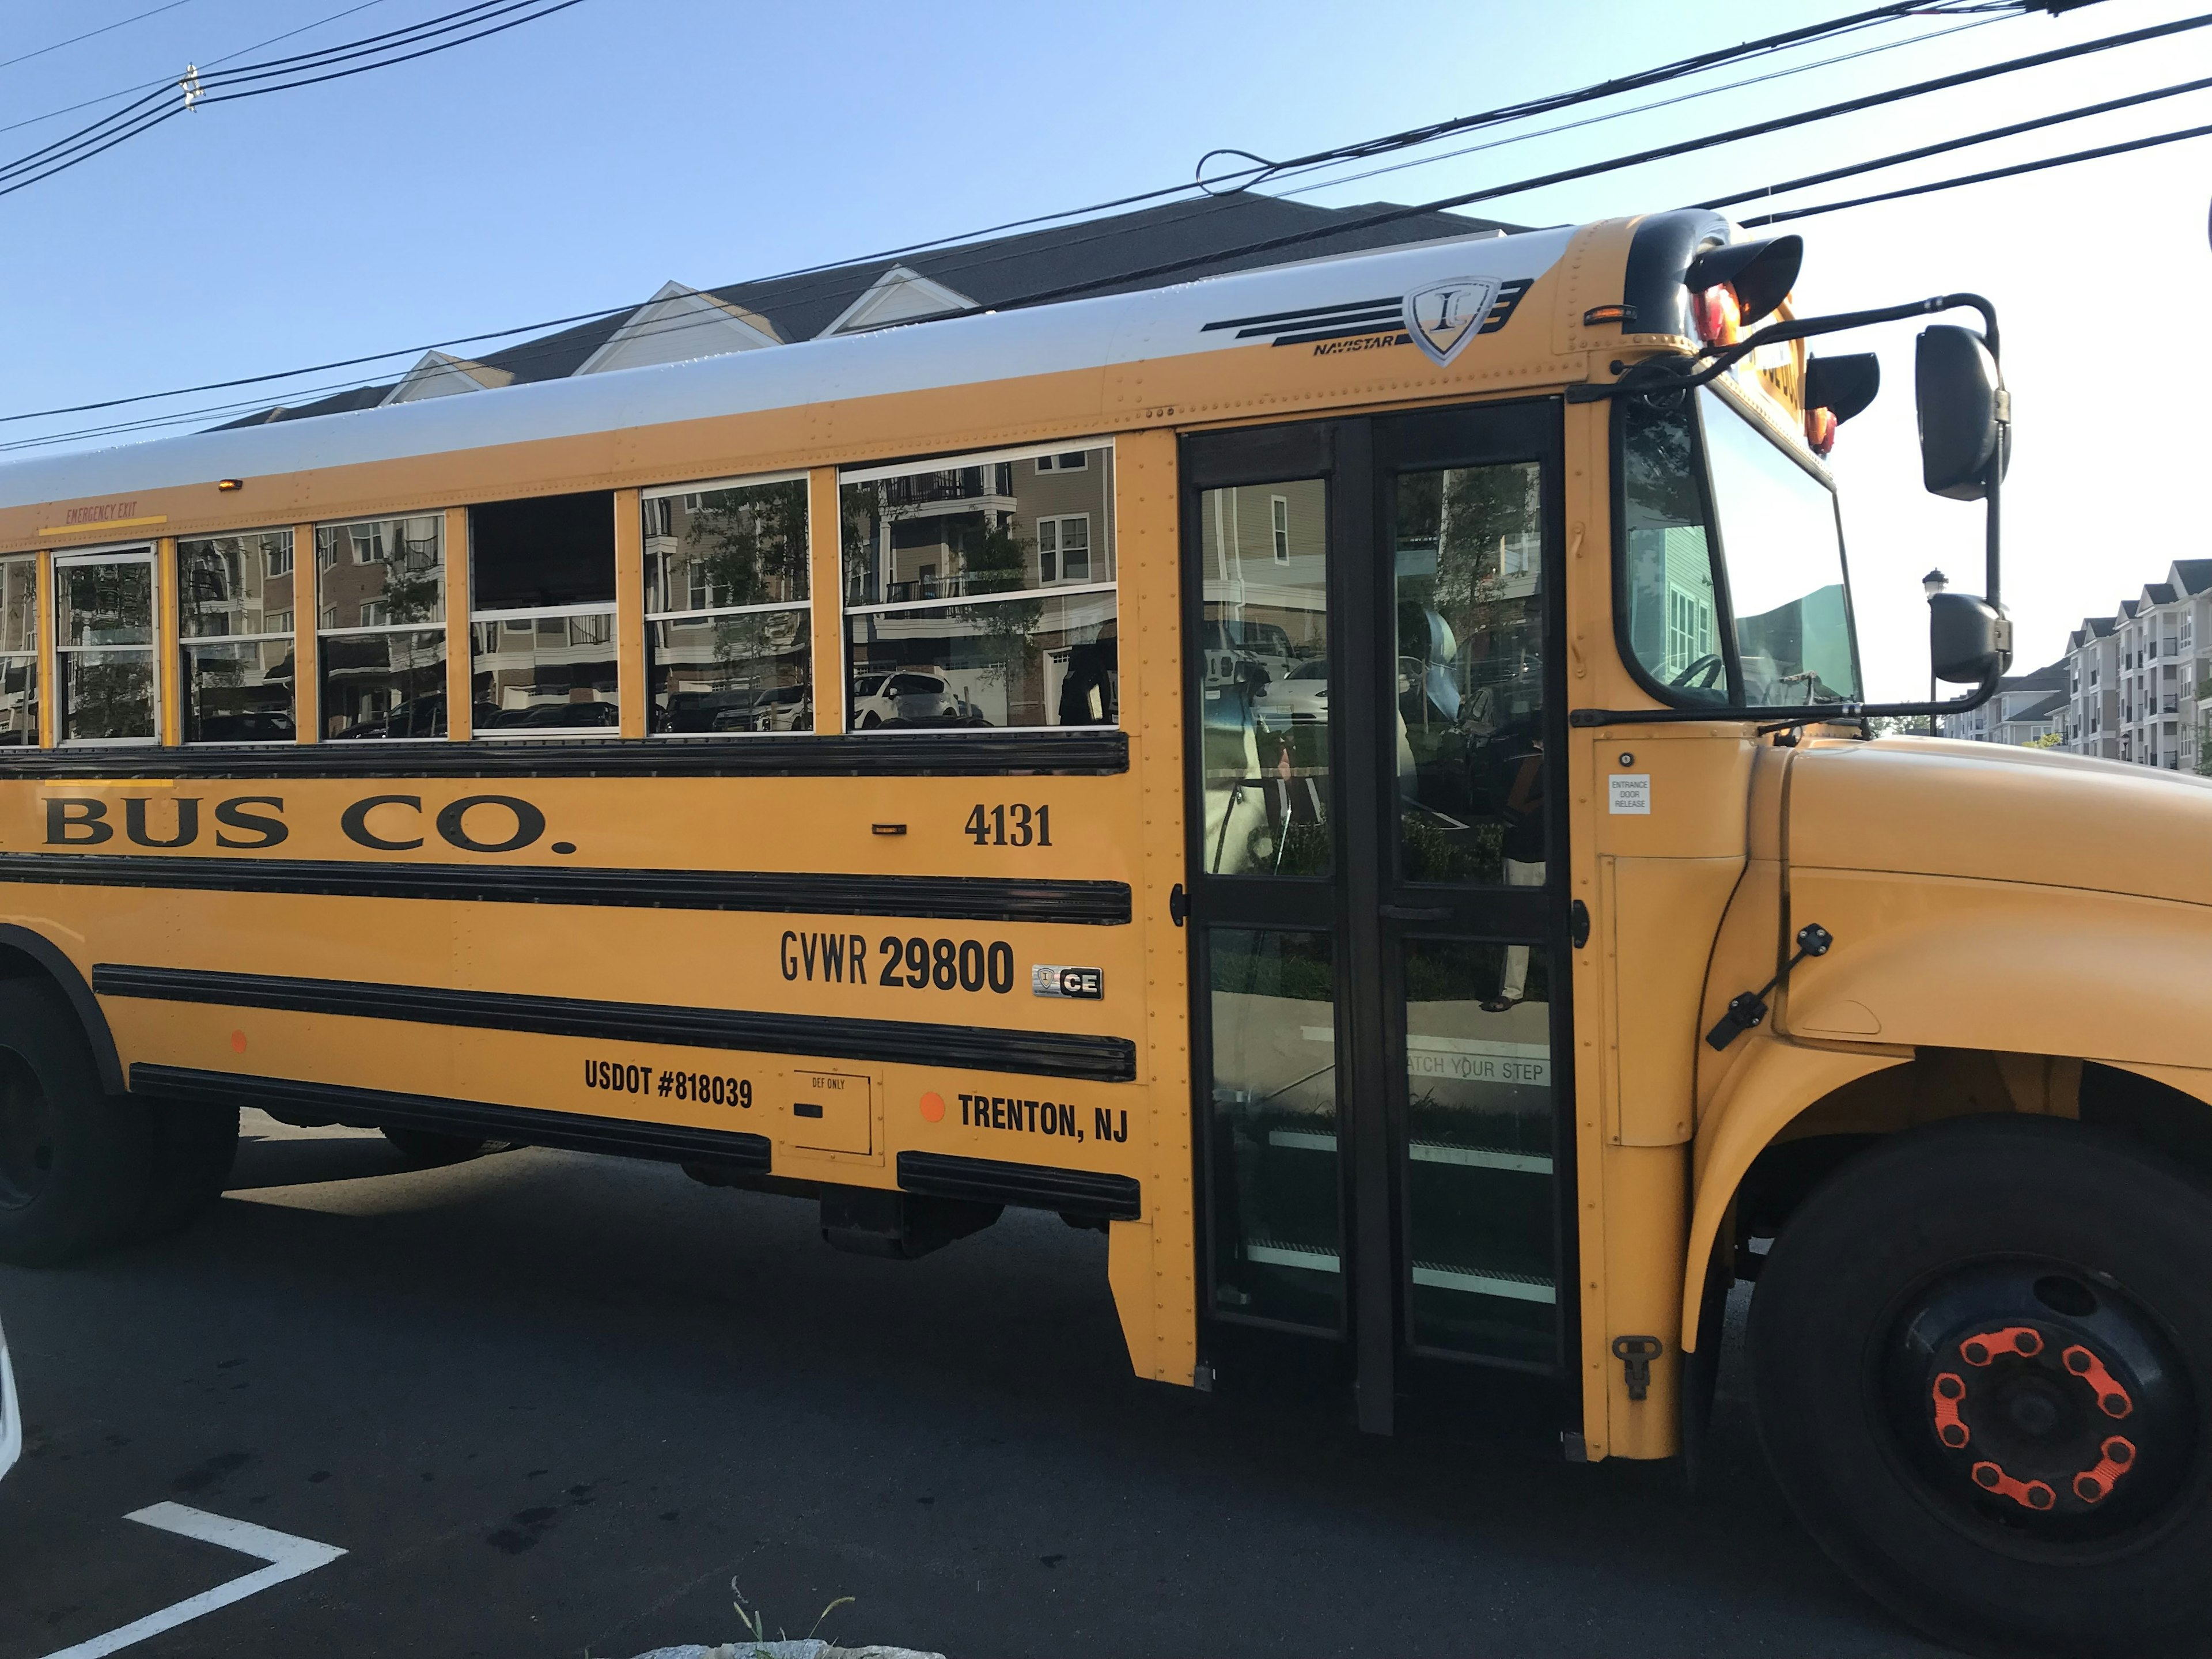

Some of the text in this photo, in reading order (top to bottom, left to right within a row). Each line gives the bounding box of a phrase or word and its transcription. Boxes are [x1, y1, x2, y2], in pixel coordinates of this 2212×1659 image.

[1313, 335, 1393, 356] NAVISTAR
[66, 501, 138, 524] EMERGENCY EXIT
[42, 794, 577, 855] BUS CO.
[964, 803, 1052, 847] 4131
[781, 930, 1014, 994] GVWR 29800
[1064, 973, 1098, 993] CE
[585, 1059, 752, 1109] USDOT #818039
[812, 1077, 845, 1090] DEF ONLY
[1407, 1055, 1543, 1080] ATCH YOUR STEP
[958, 1093, 1127, 1143] TRENTON, NJ
